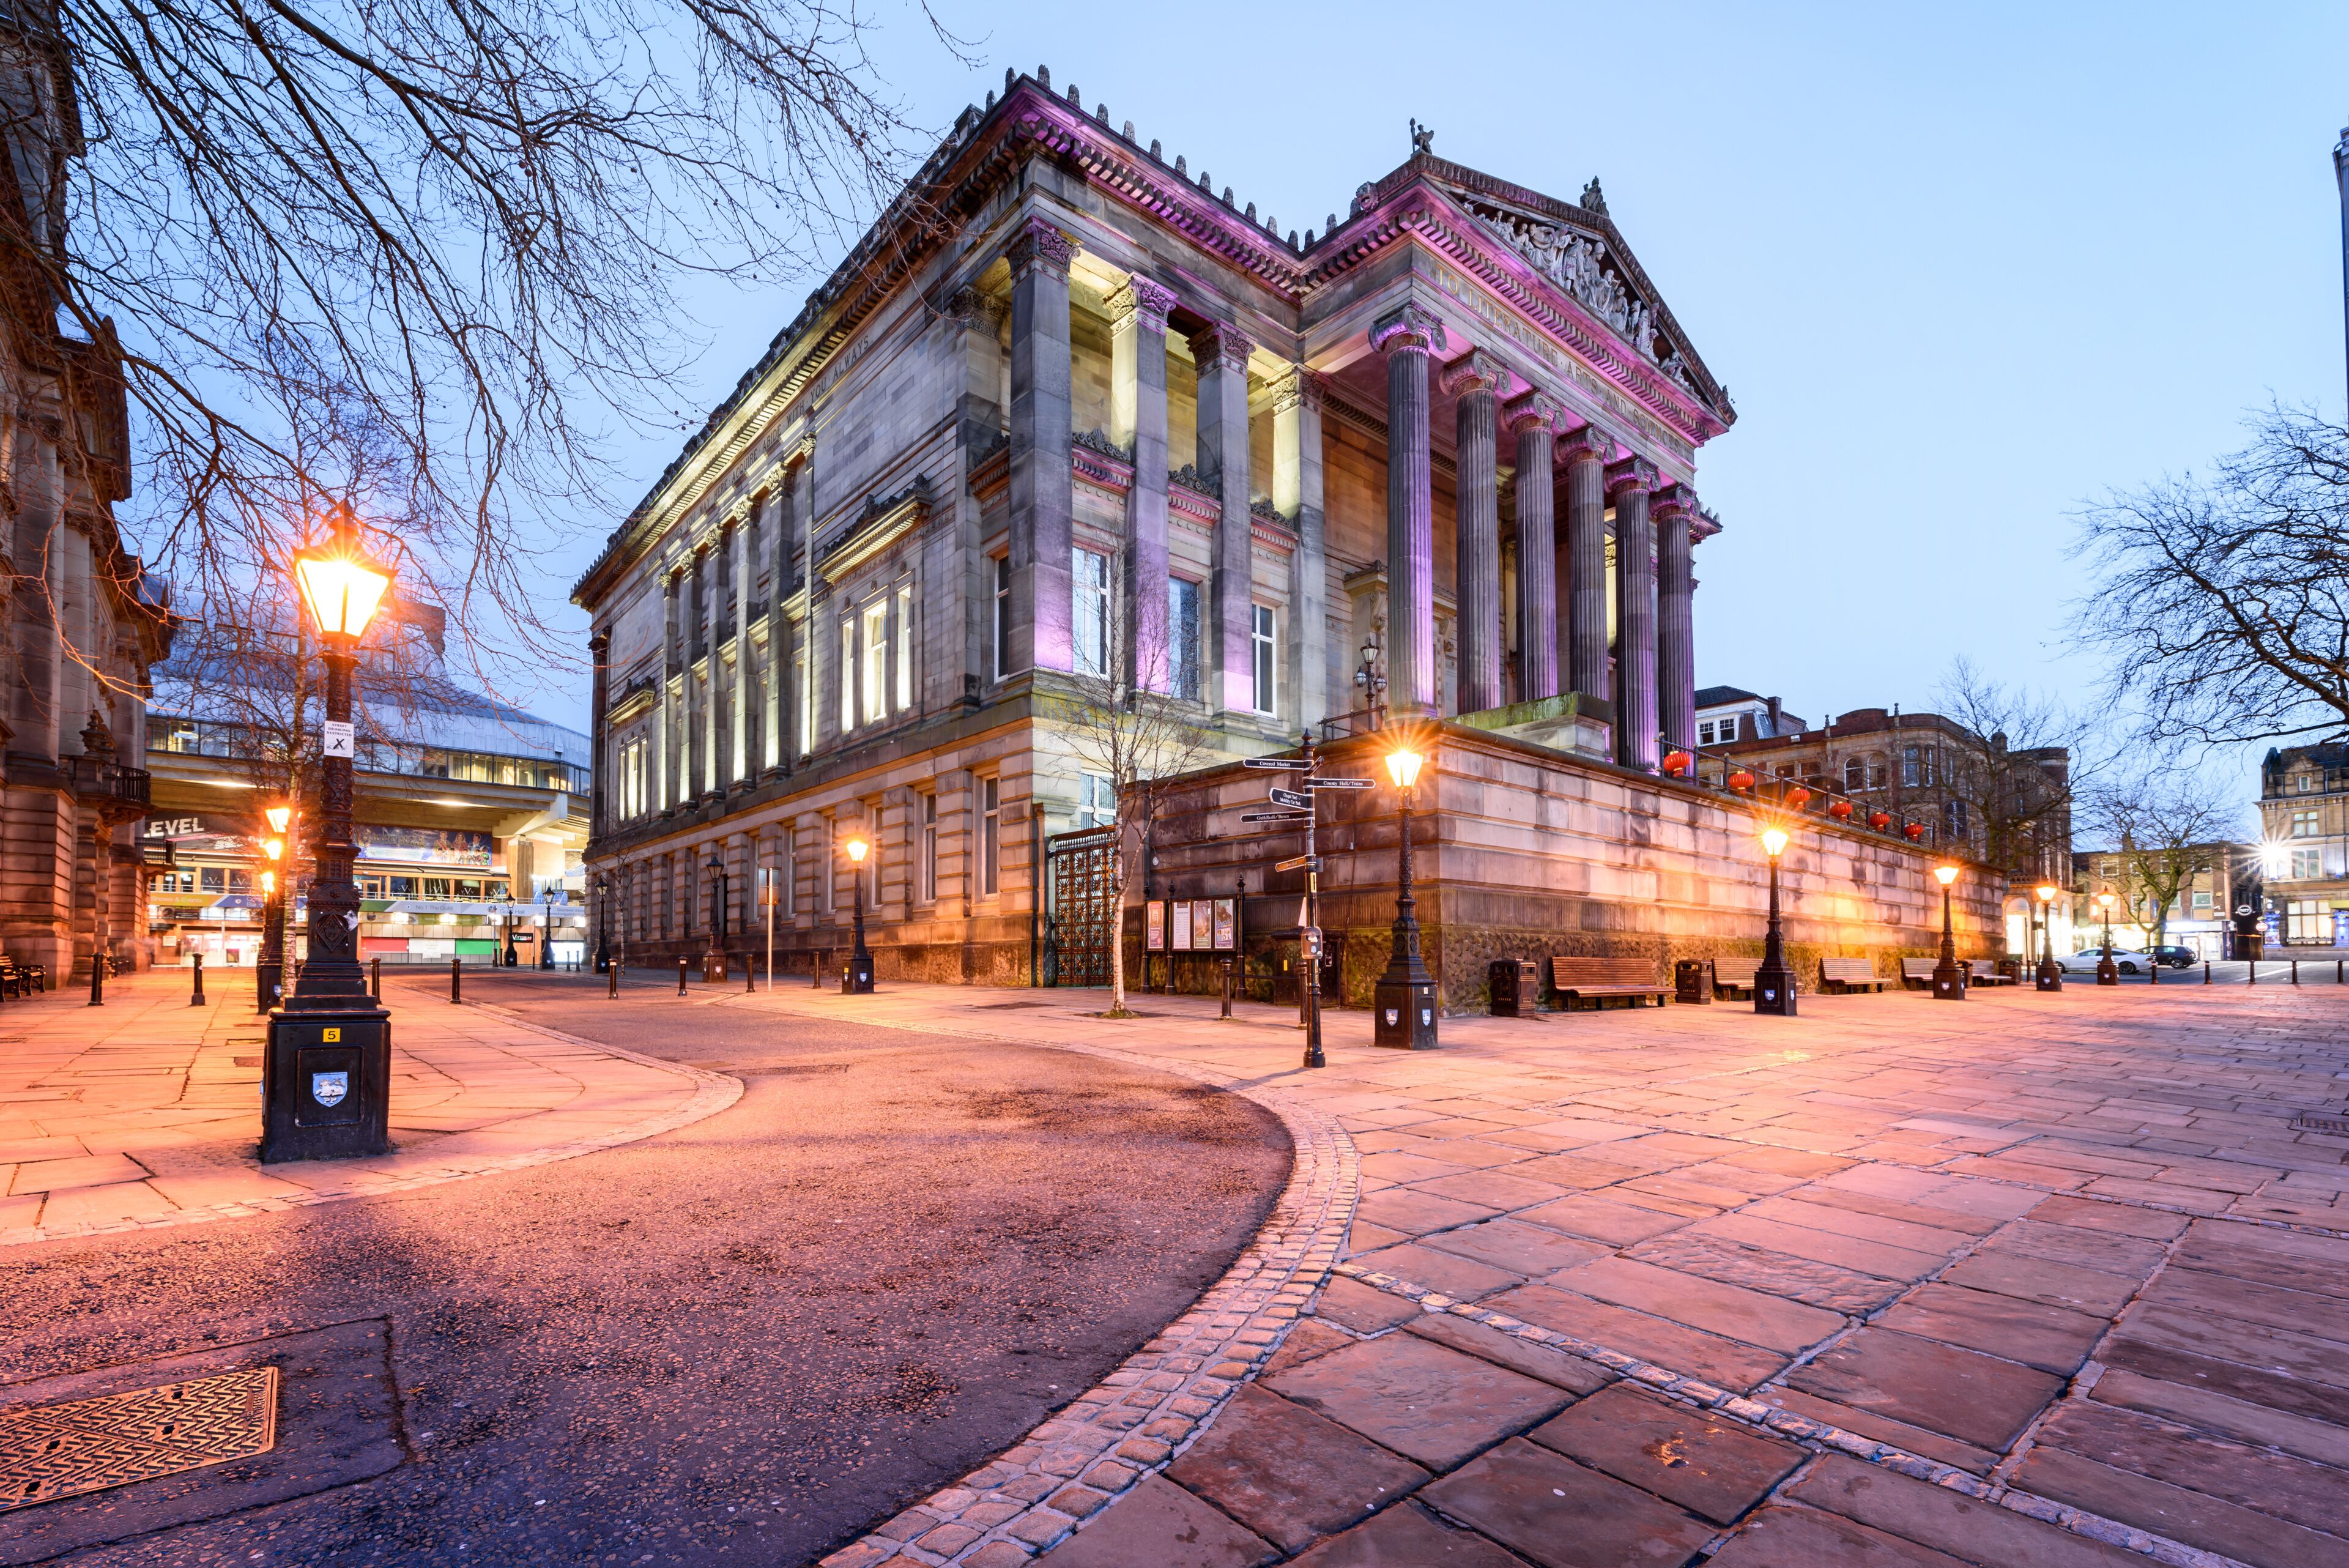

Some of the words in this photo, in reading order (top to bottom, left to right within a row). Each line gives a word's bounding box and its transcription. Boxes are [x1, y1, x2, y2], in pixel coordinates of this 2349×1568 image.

[1436, 265, 1458, 294] TO
[1469, 289, 1557, 367] LITERATURE
[1567, 361, 1598, 395] ARTS
[1606, 390, 1627, 416] AND
[1633, 409, 1680, 453] SCIENCES
[327, 1031, 336, 1039] 5
